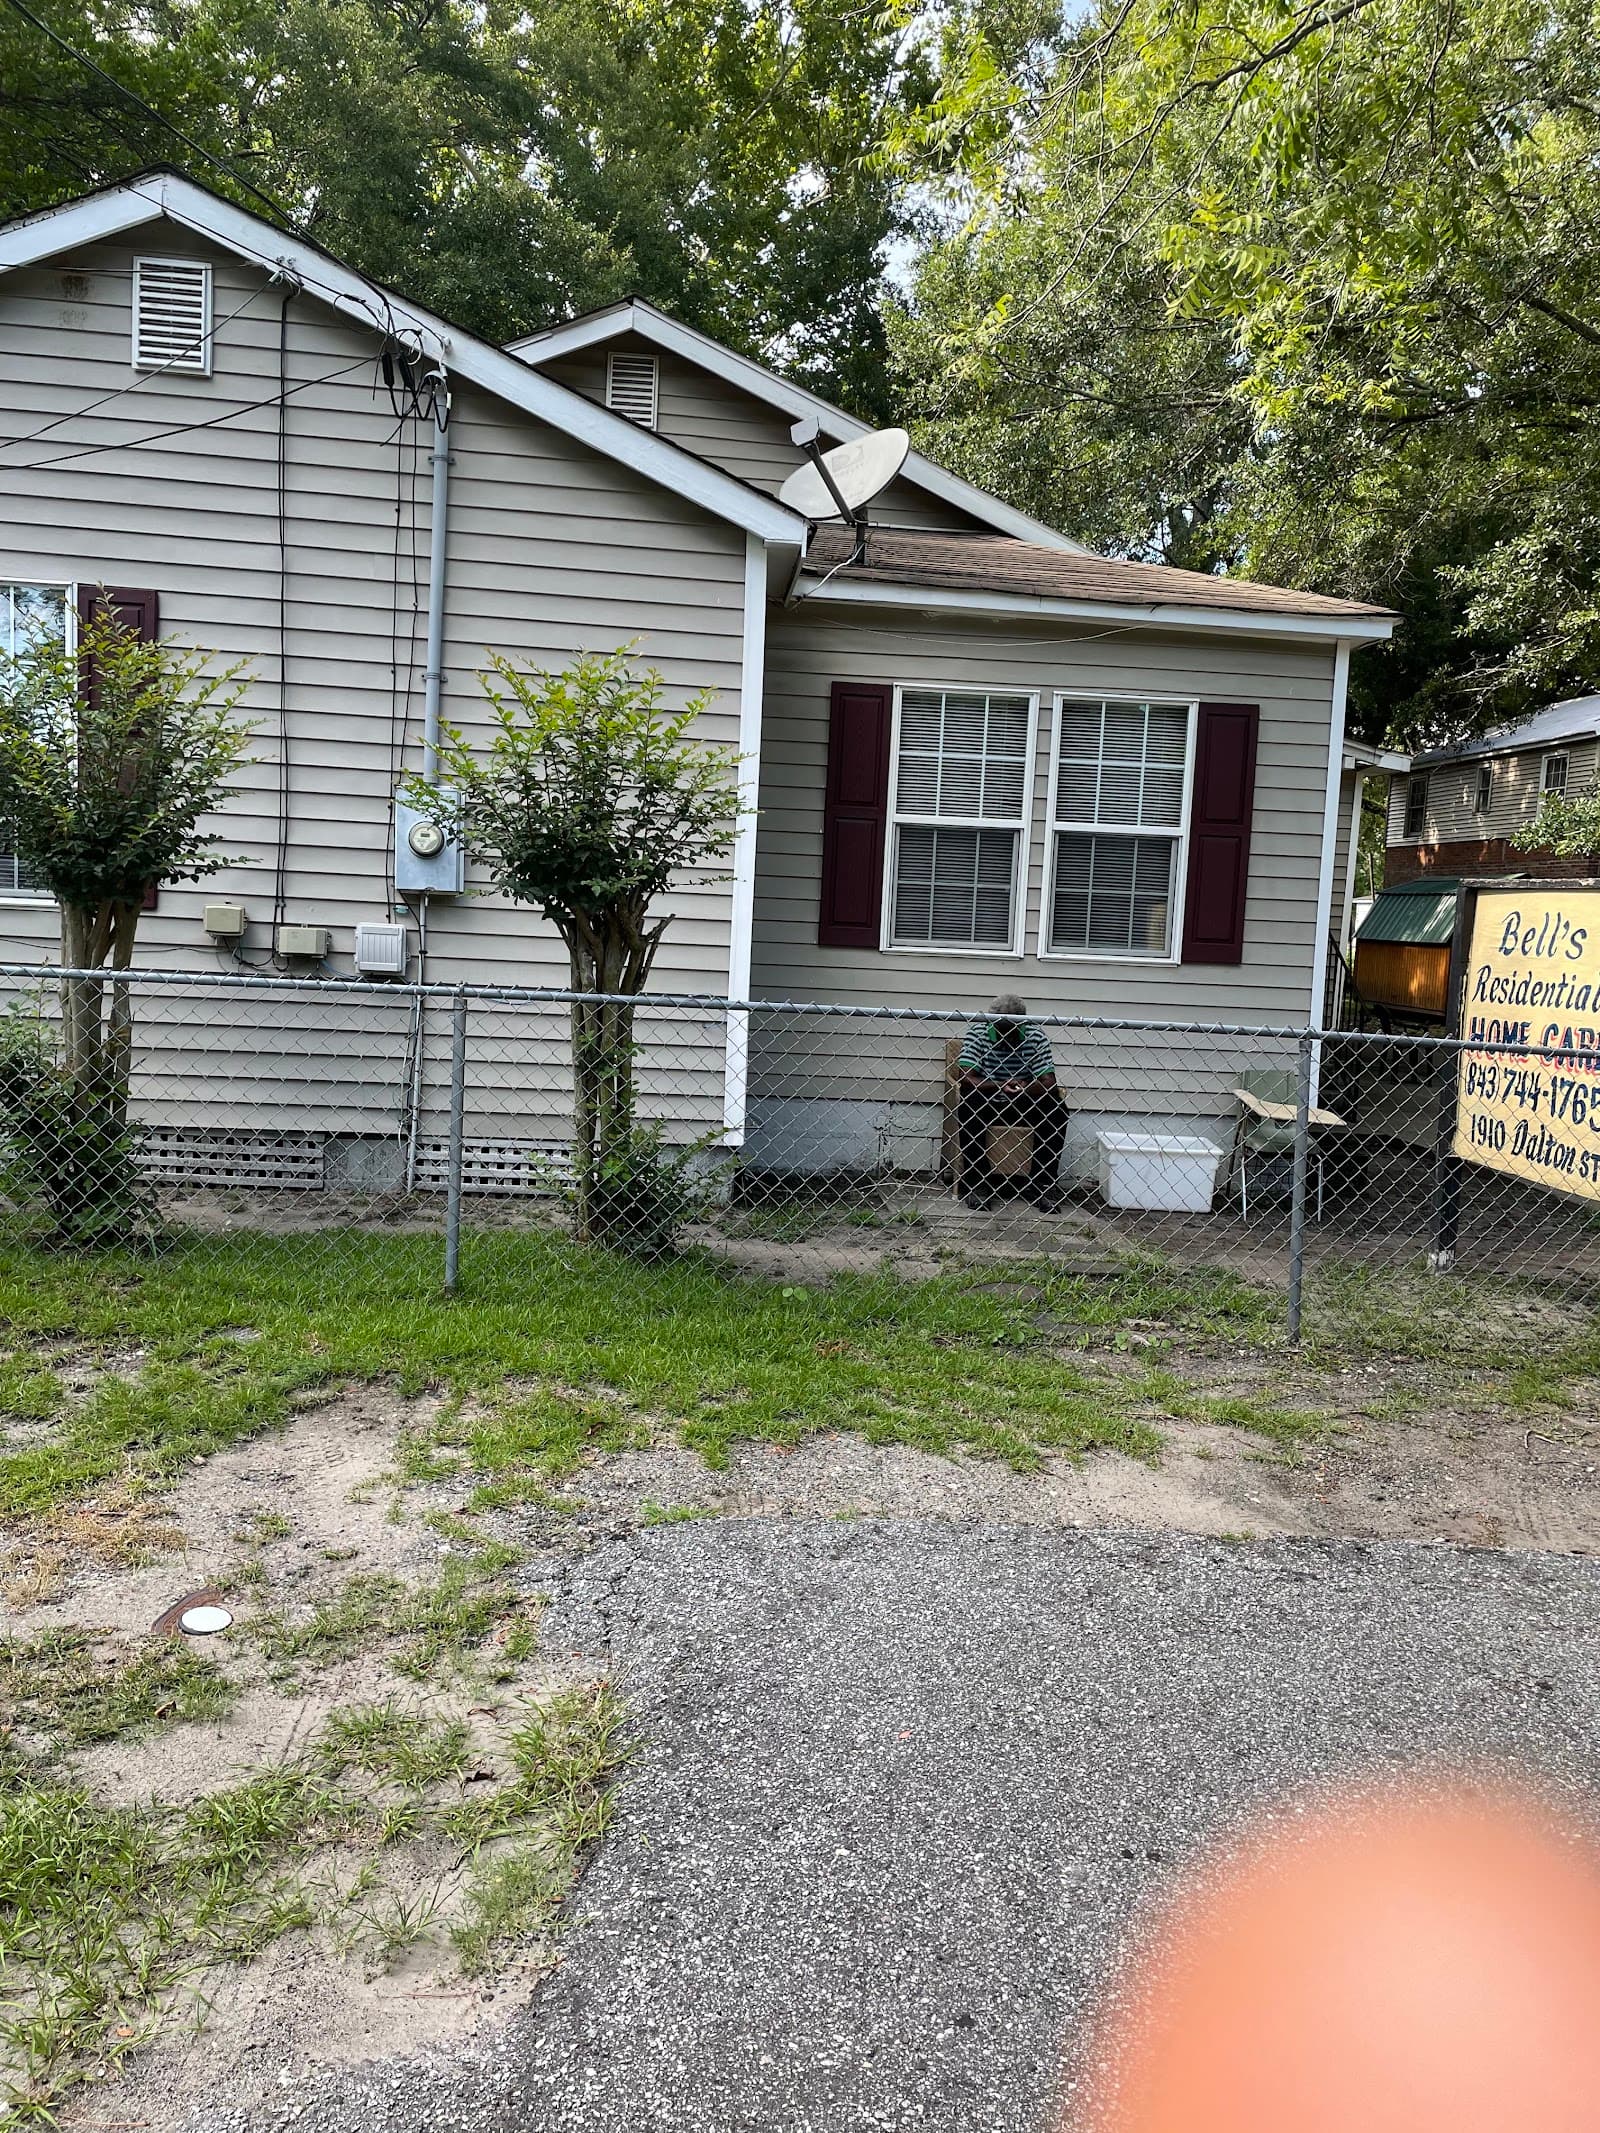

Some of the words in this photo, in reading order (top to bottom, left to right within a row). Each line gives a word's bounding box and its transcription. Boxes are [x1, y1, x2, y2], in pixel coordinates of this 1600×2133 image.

[1497, 911, 1587, 960] Bell's
[1467, 1016, 1532, 1062] HOME
[1471, 1114, 1506, 1152] 1910
[1511, 1119, 1577, 1175] Dalton
